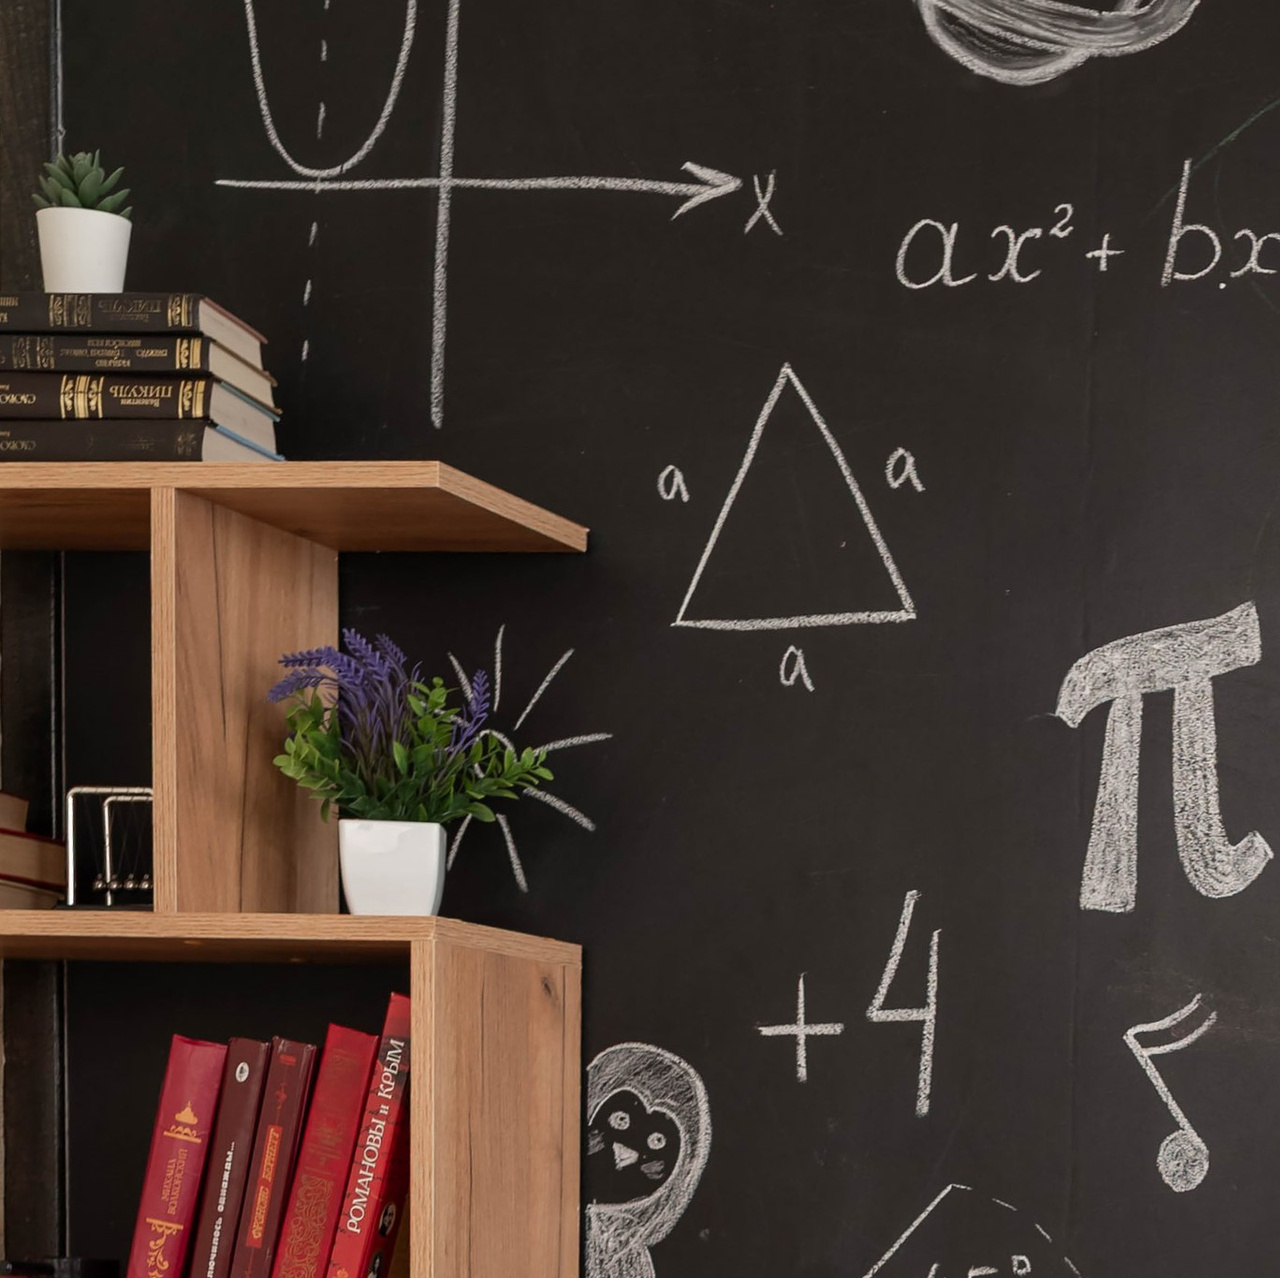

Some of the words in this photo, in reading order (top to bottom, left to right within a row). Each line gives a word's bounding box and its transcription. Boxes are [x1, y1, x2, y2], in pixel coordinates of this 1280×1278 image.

[109, 384, 173, 399] ПИКУЛЬ
[657, 464, 690, 503] a
[885, 447, 926, 493] a
[779, 644, 816, 693] a
[347, 1117, 387, 1234] РОМАНОВЫ
[377, 1039, 405, 1100] КРЫМ
